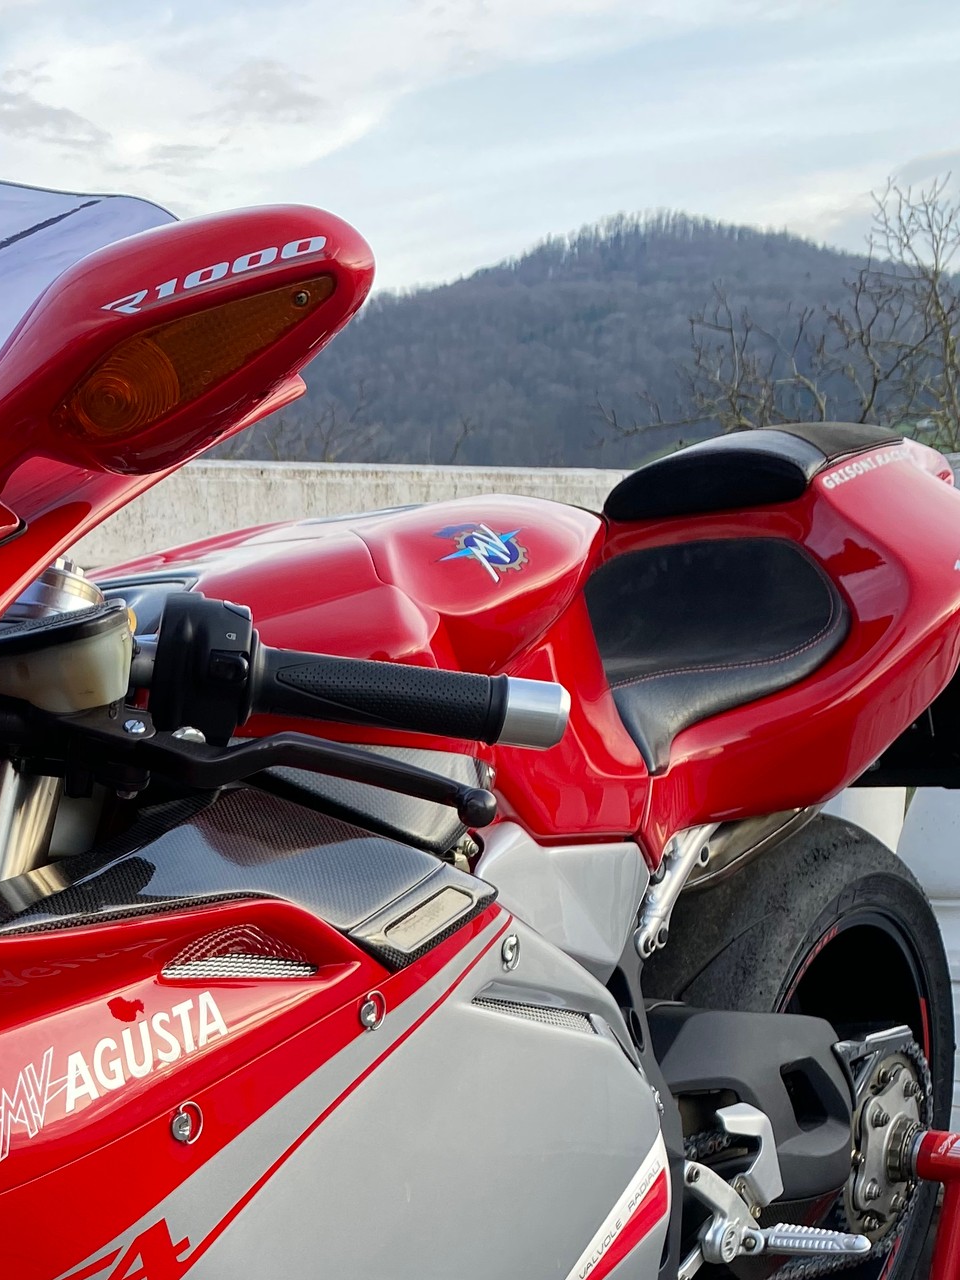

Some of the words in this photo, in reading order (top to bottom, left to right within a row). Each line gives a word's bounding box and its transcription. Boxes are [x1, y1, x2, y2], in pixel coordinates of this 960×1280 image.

[100, 236, 327, 314] R1000
[822, 456, 877, 489] GRISONI
[65, 991, 230, 1113] AGUSTA
[579, 1218, 623, 1279] VALVOLE
